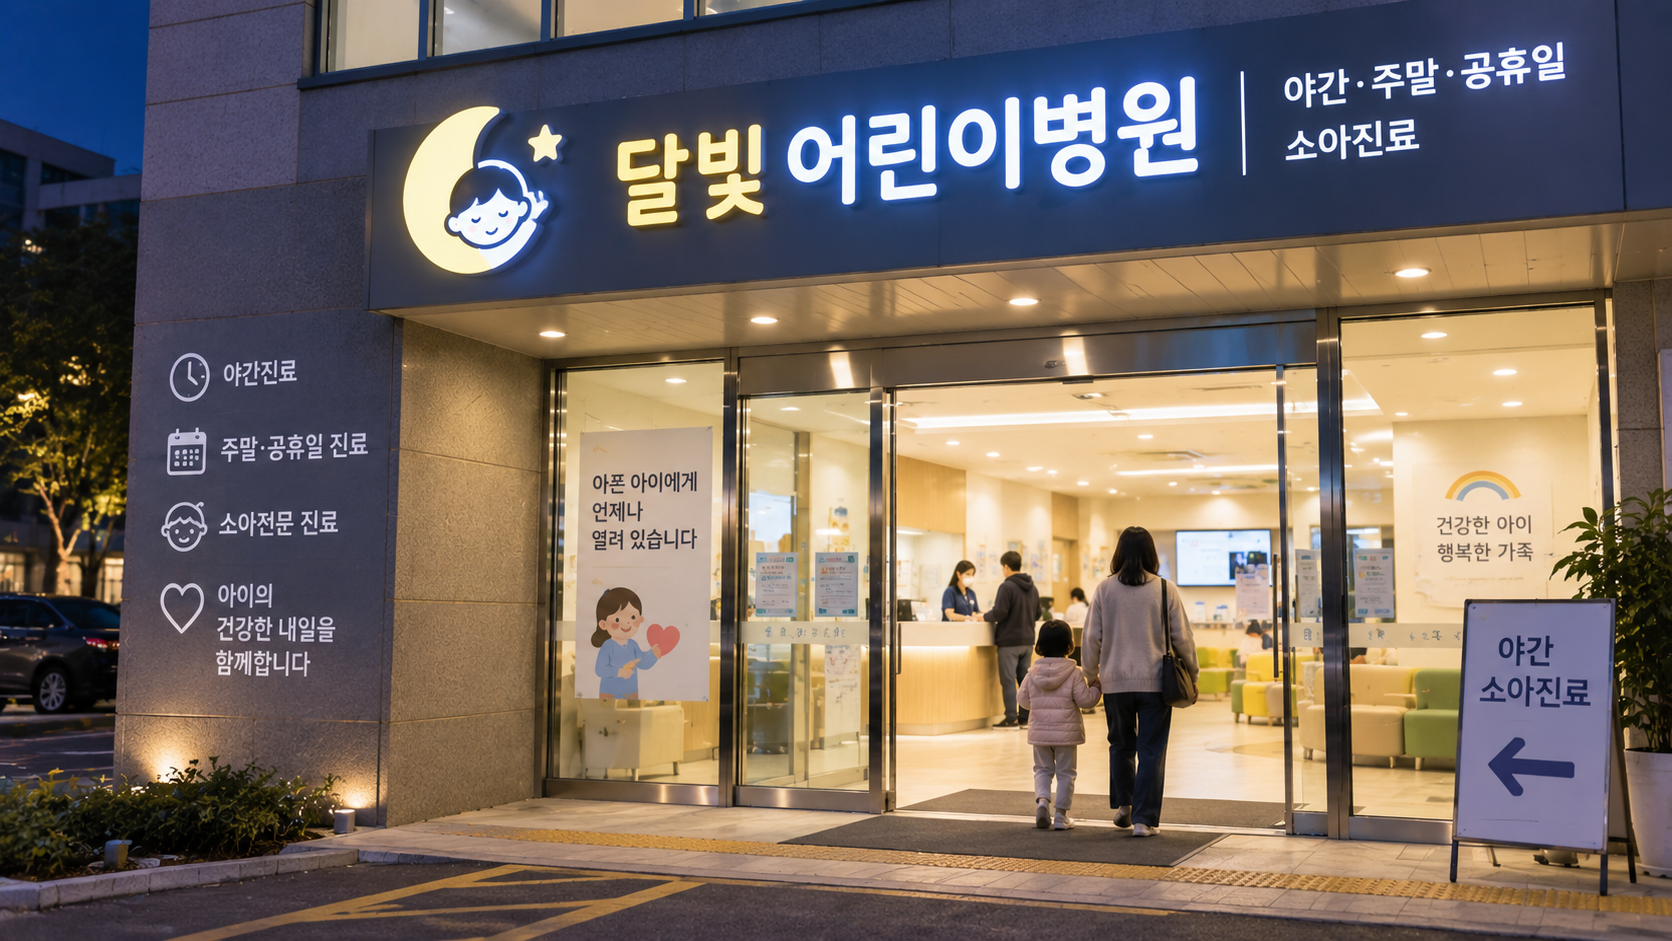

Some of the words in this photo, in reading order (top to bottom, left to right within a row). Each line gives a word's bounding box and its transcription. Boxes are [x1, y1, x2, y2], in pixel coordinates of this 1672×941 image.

[617, 124, 764, 227] 달빛
[787, 75, 1199, 205] 어린이병원
[1285, 118, 1420, 161] 소아진료
[223, 359, 298, 387] 야간진료
[329, 432, 369, 458] 진료
[630, 470, 697, 494] 아이에게
[218, 510, 294, 537] 소아전문
[300, 509, 339, 536] 진료
[592, 500, 644, 523] 언제나
[1437, 515, 1491, 536] 건강한
[1496, 514, 1532, 535] 아이
[592, 529, 624, 551] 열려
[630, 528, 698, 550] 있습니다
[1437, 542, 1492, 563] 행복한
[1498, 542, 1534, 562] 가족
[217, 583, 273, 609] 아이의
[216, 615, 273, 642] 건강한
[278, 616, 336, 643] 내일을
[215, 649, 311, 677] 함께합니다
[1498, 635, 1554, 667] 야간
[1479, 675, 1591, 708] 소아진료
